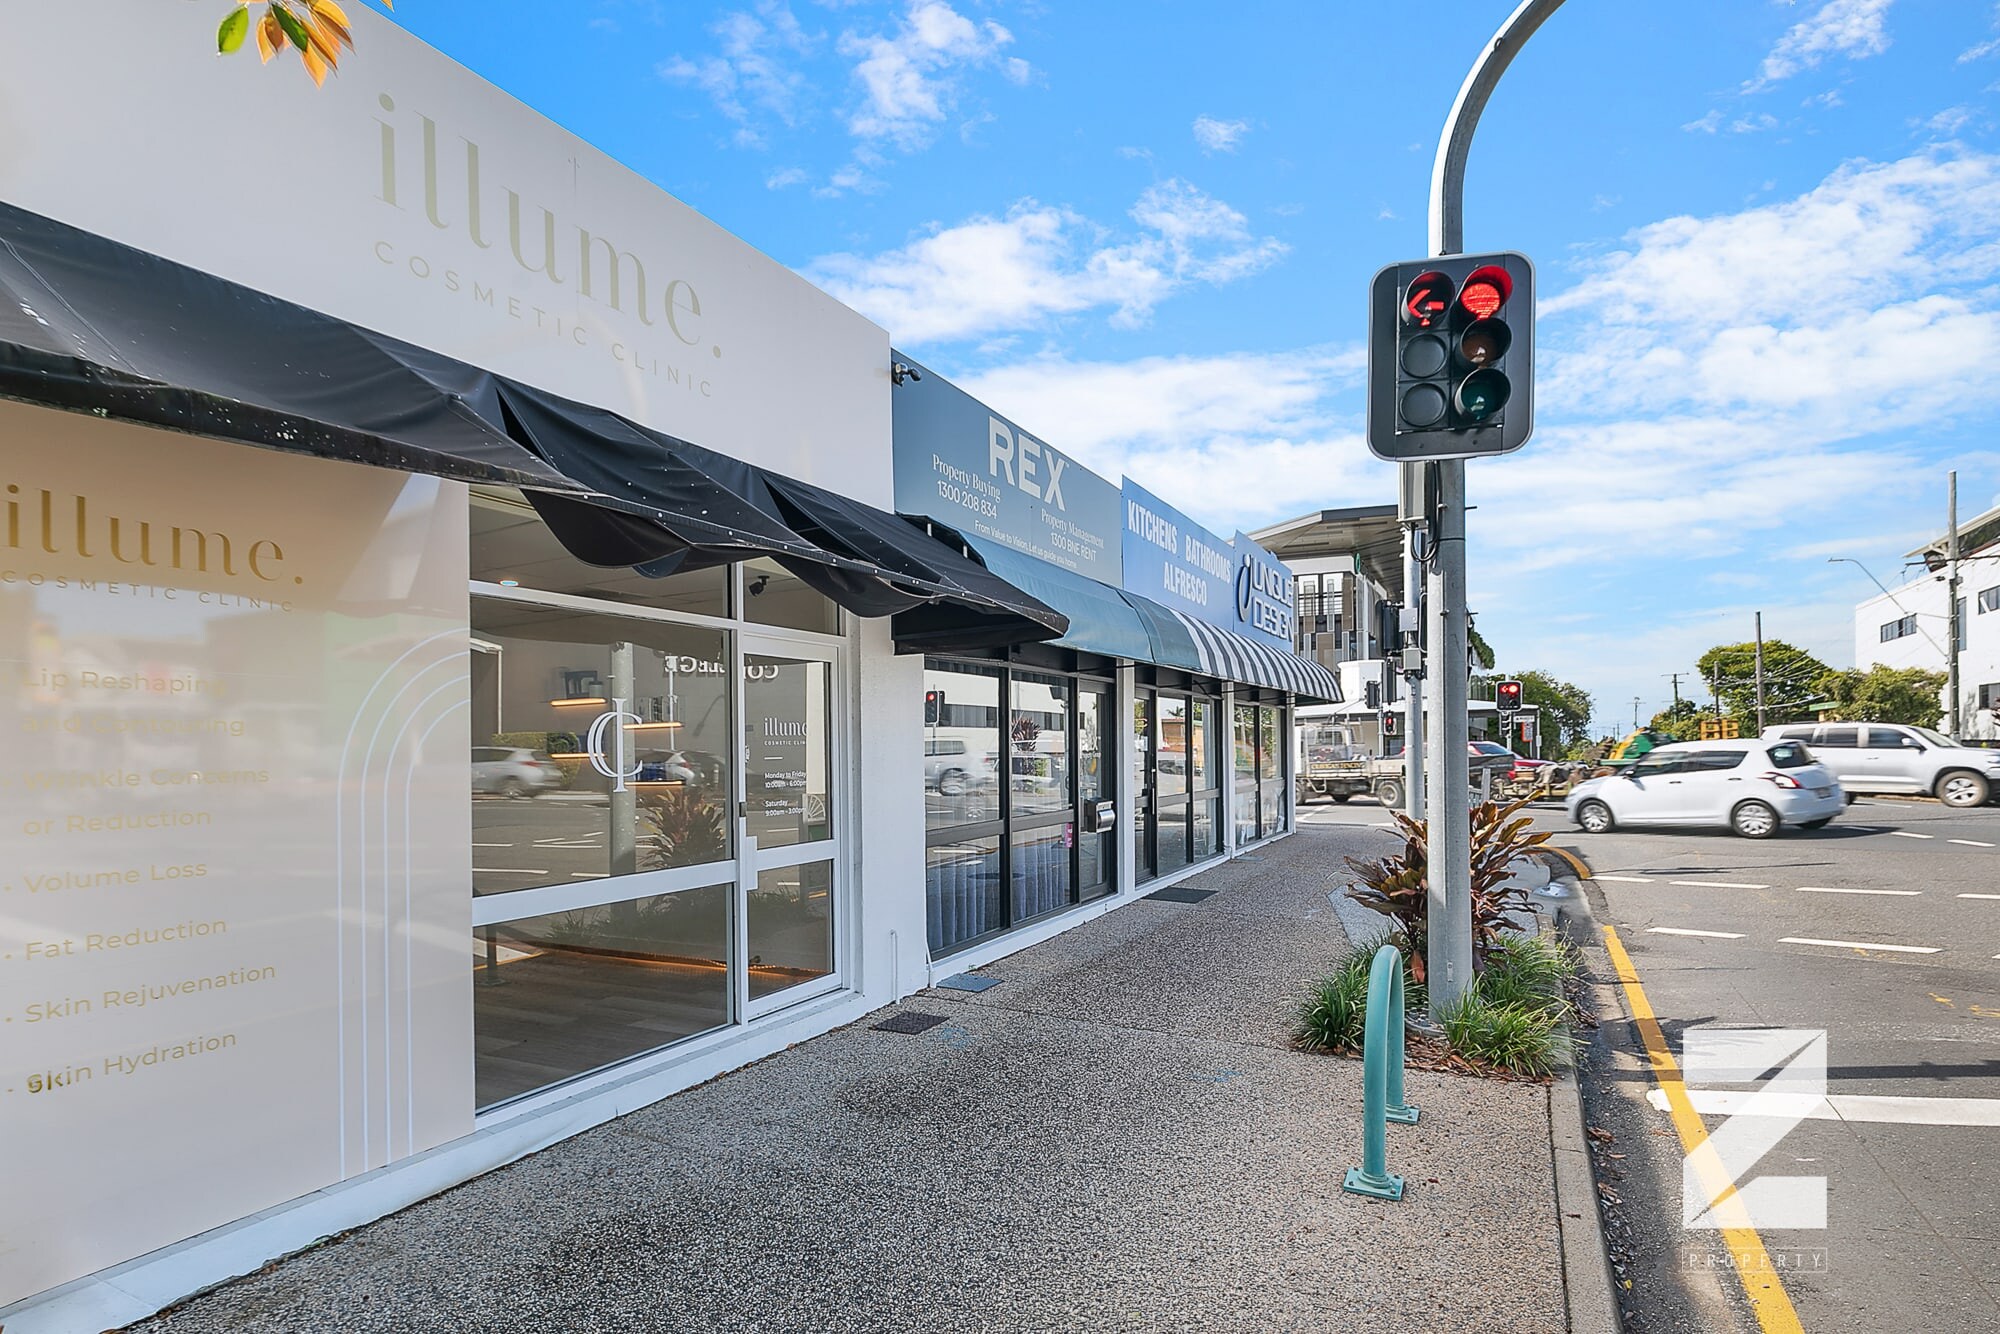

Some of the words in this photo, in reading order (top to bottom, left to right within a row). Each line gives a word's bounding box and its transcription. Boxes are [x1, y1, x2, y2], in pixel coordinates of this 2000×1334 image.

[371, 93, 721, 359] illume.
[375, 241, 586, 345] COSMETIC
[611, 343, 711, 397] CLINIC
[933, 454, 971, 488] Property
[973, 473, 1001, 503] Buying
[989, 416, 1065, 512] REX
[938, 480, 960, 503] 1300
[962, 491, 979, 511] 208
[981, 499, 997, 519] 834
[0, 484, 303, 584] illume.
[974, 520, 990, 534] From
[991, 526, 1006, 540] Value
[1006, 533, 1012, 543] to
[1042, 508, 1067, 534] Property
[1068, 521, 1104, 549] Management
[1051, 532, 1066, 549] 1300
[1067, 539, 1080, 556] BNE
[1081, 545, 1097, 562] RENT
[1127, 499, 1178, 554] KITCHENS
[1185, 534, 1231, 584] BATHROOMS
[1, 570, 177, 600] COSMETIC
[198, 591, 293, 612] CLINIC
[1163, 561, 1207, 606] ALFRESCO
[22, 667, 70, 691] Lip
[80, 671, 228, 696] Reshaping
[20, 713, 81, 733] and
[92, 713, 245, 737] Contouring
[23, 768, 141, 790] Wrinkle
[150, 768, 270, 786] Concerns
[764, 771, 785, 780] Monday
[23, 818, 54, 836] or
[66, 809, 212, 833] Reduction
[764, 800, 788, 808] Saturday
[23, 869, 140, 893] Volume
[150, 863, 208, 881] Loss
[26, 939, 75, 961] Fat
[86, 919, 227, 953] Reduction
[25, 998, 91, 1023] Skin
[103, 963, 276, 1008] Rejuvenation
[26, 1065, 92, 1094] Skin
[104, 1033, 237, 1075] Hydration
